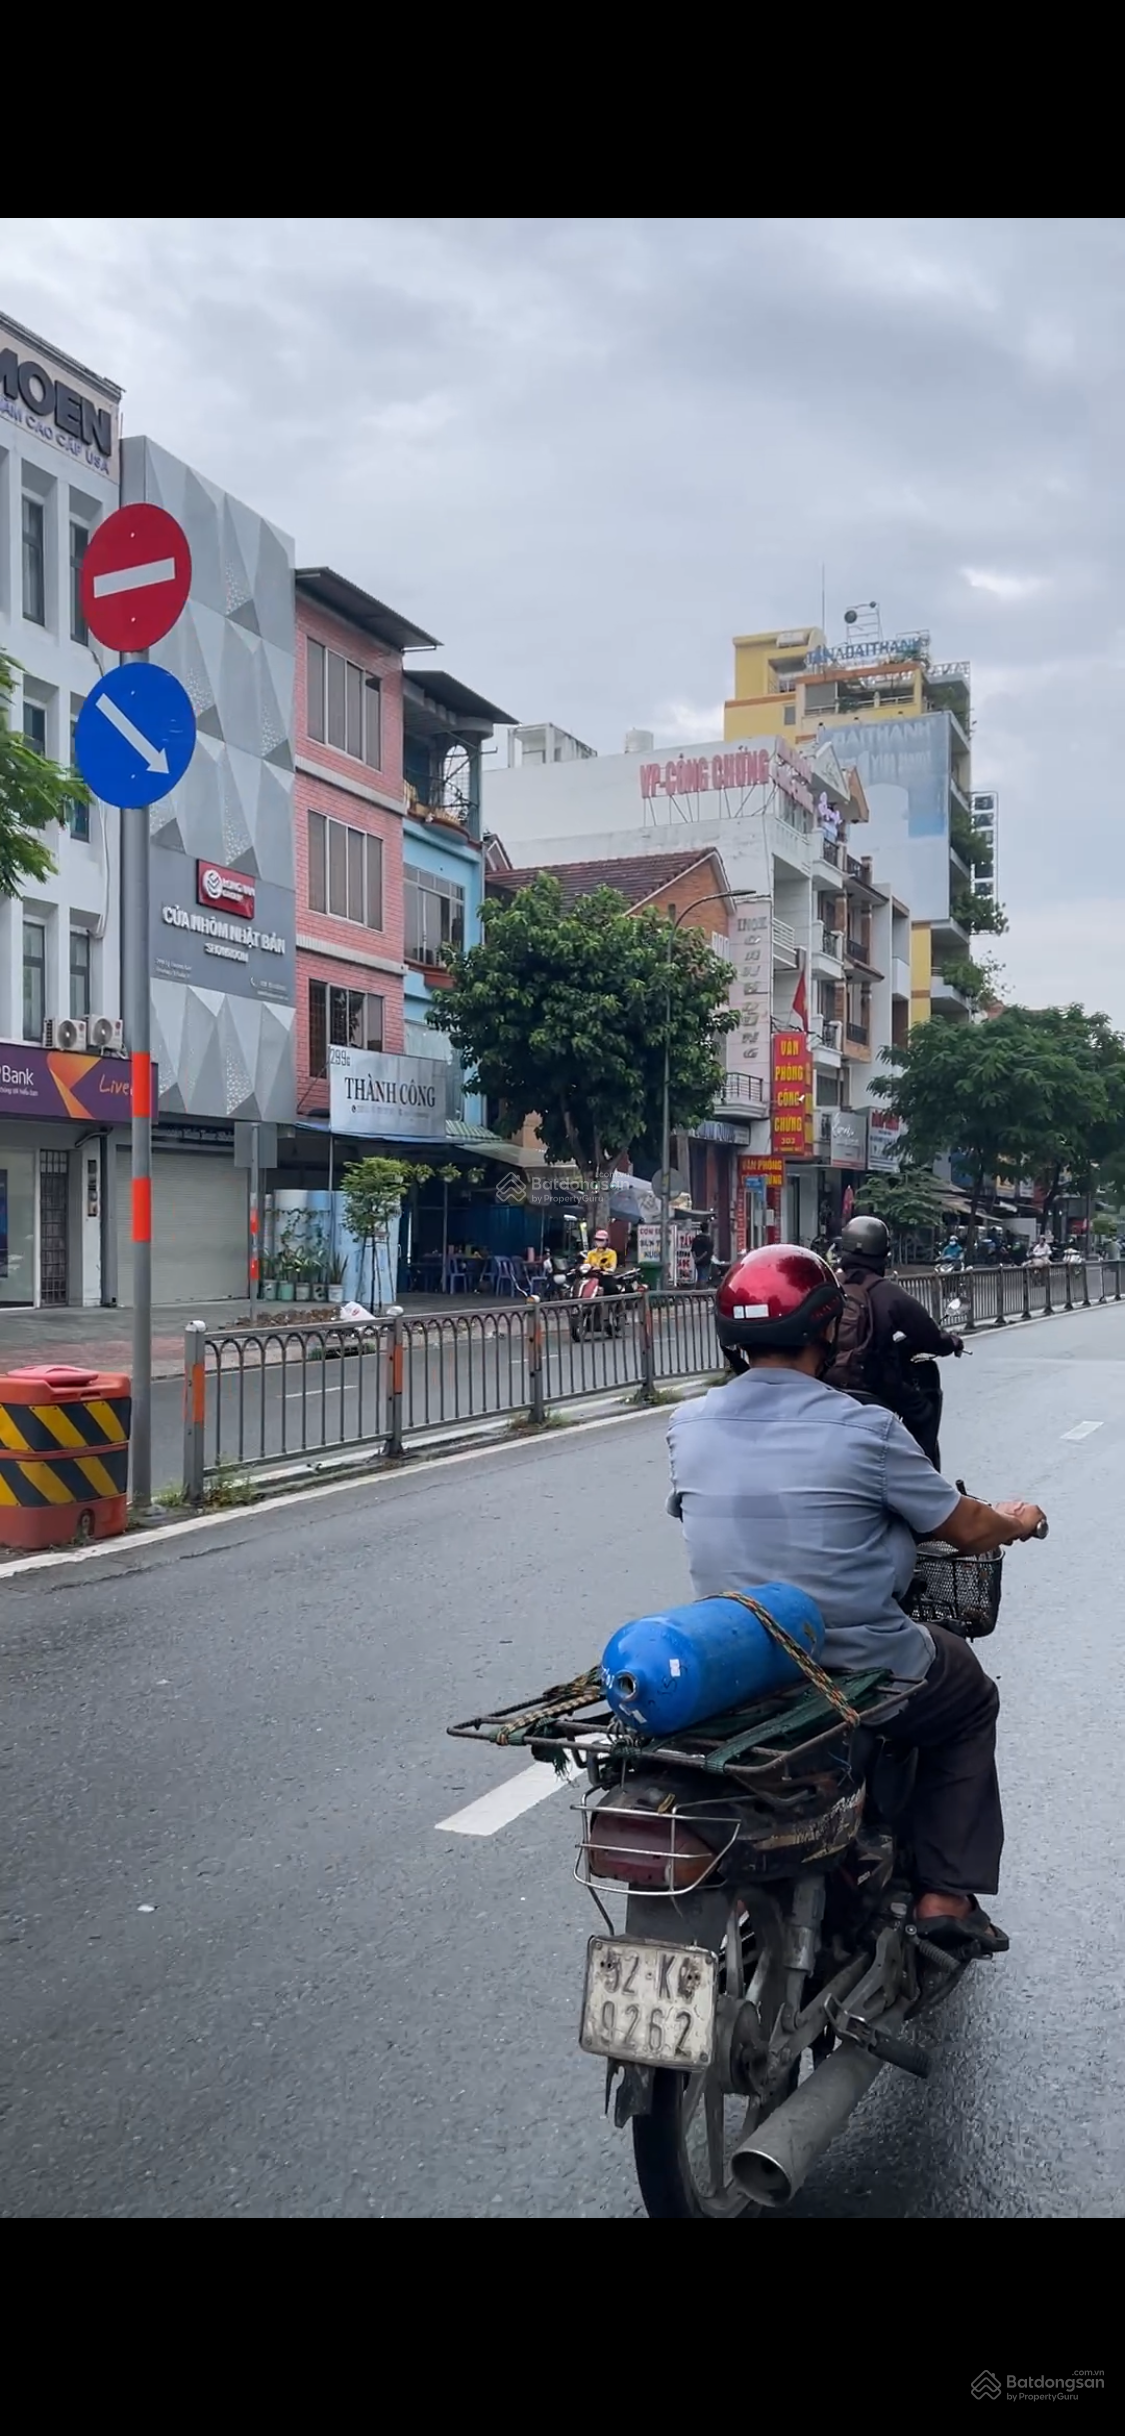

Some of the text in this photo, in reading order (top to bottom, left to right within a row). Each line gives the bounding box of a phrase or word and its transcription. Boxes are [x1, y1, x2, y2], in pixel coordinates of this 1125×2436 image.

[85, 446, 110, 475] USA
[190, 915, 228, 940] NHÔM
[260, 932, 286, 955] BẢN
[0, 1064, 34, 1086] Bank
[775, 1062, 804, 1081] PHÒNG
[344, 1073, 436, 1108] THÀNH CÔNG
[601, 2000, 692, 2057] 9262
